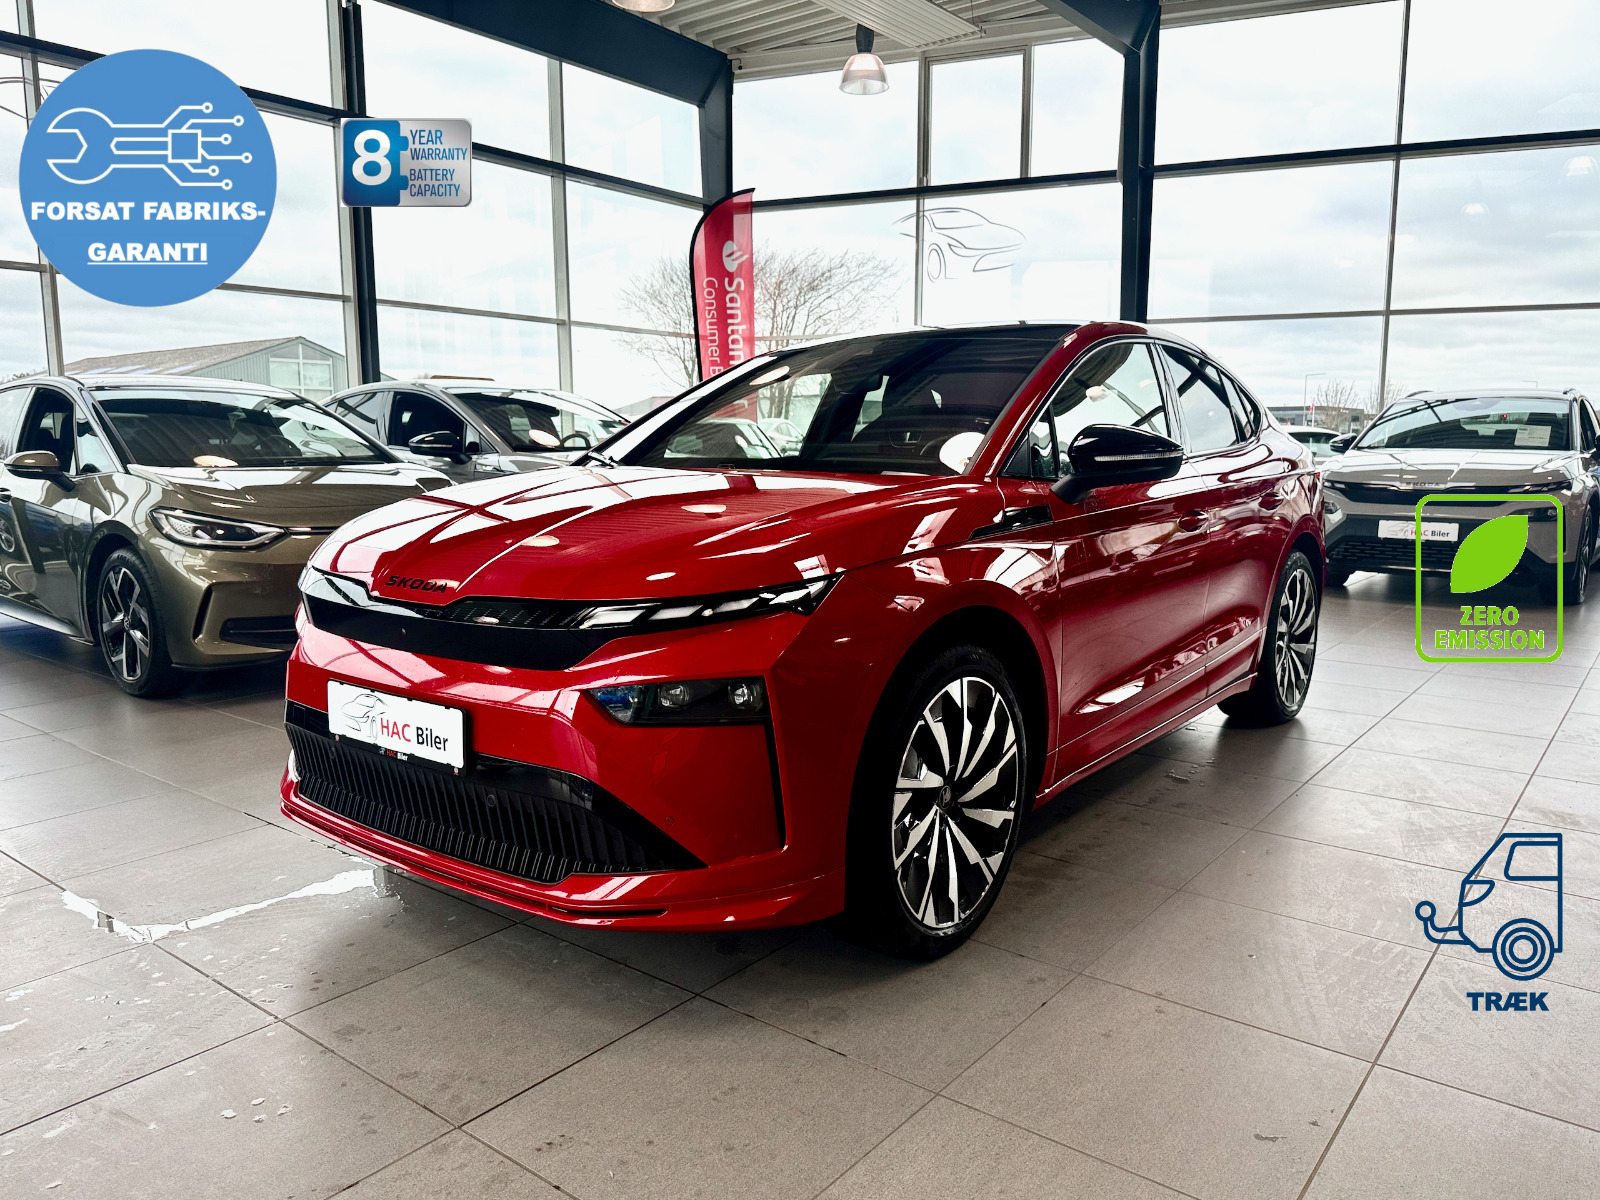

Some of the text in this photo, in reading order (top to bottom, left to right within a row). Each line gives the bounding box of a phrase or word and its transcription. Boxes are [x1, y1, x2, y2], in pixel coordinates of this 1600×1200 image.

[703, 276, 720, 364] Consumer
[1430, 530, 1450, 538] Biler
[380, 717, 449, 752] HAC Biler
